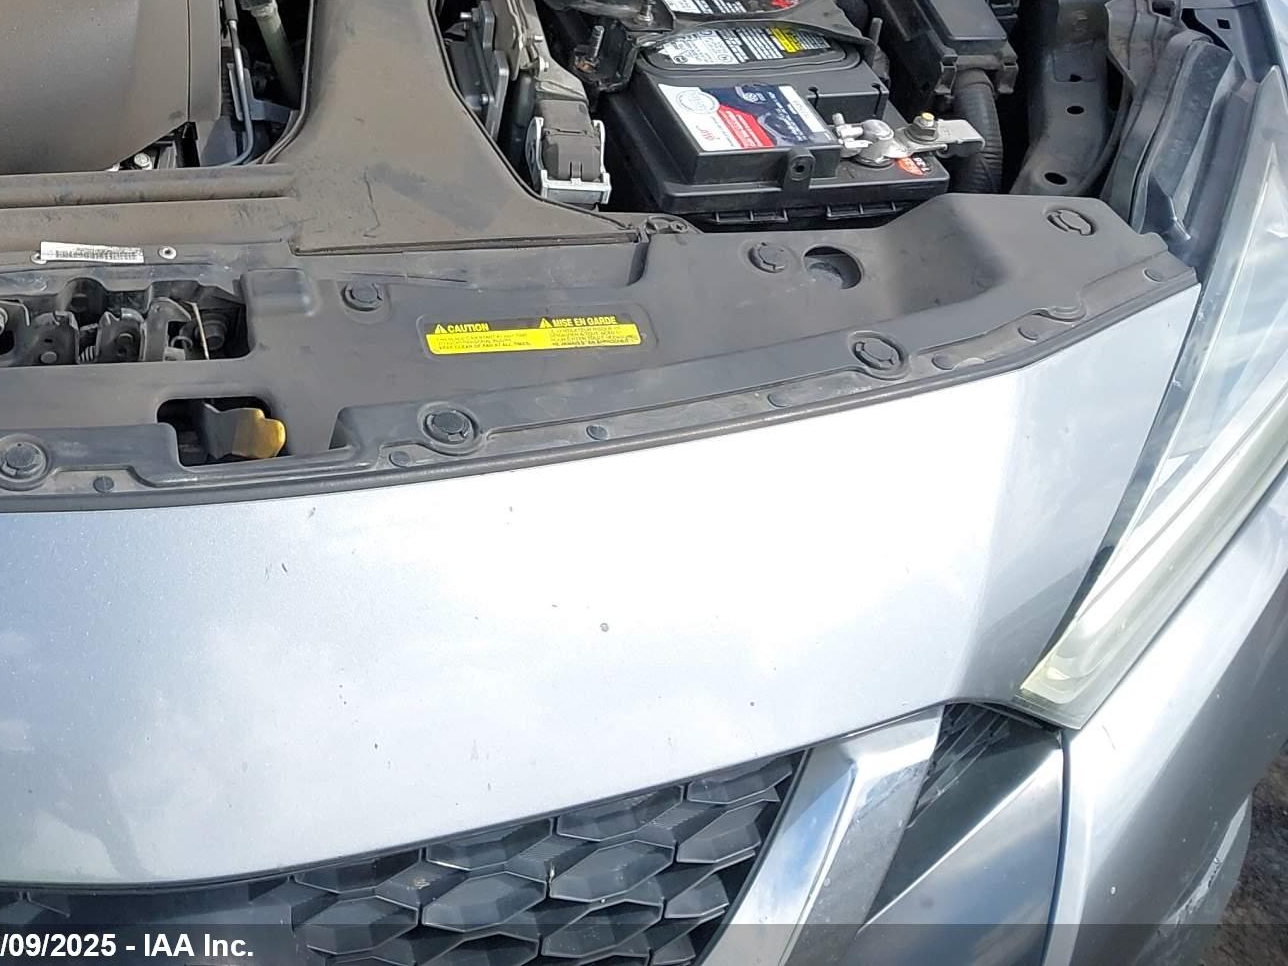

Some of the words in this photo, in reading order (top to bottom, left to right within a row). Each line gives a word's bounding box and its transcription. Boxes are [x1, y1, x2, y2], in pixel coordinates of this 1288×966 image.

[552, 318, 573, 328] MISE
[574, 317, 587, 327] EN
[587, 316, 617, 326] GARDE
[447, 323, 490, 334] CAUTION
